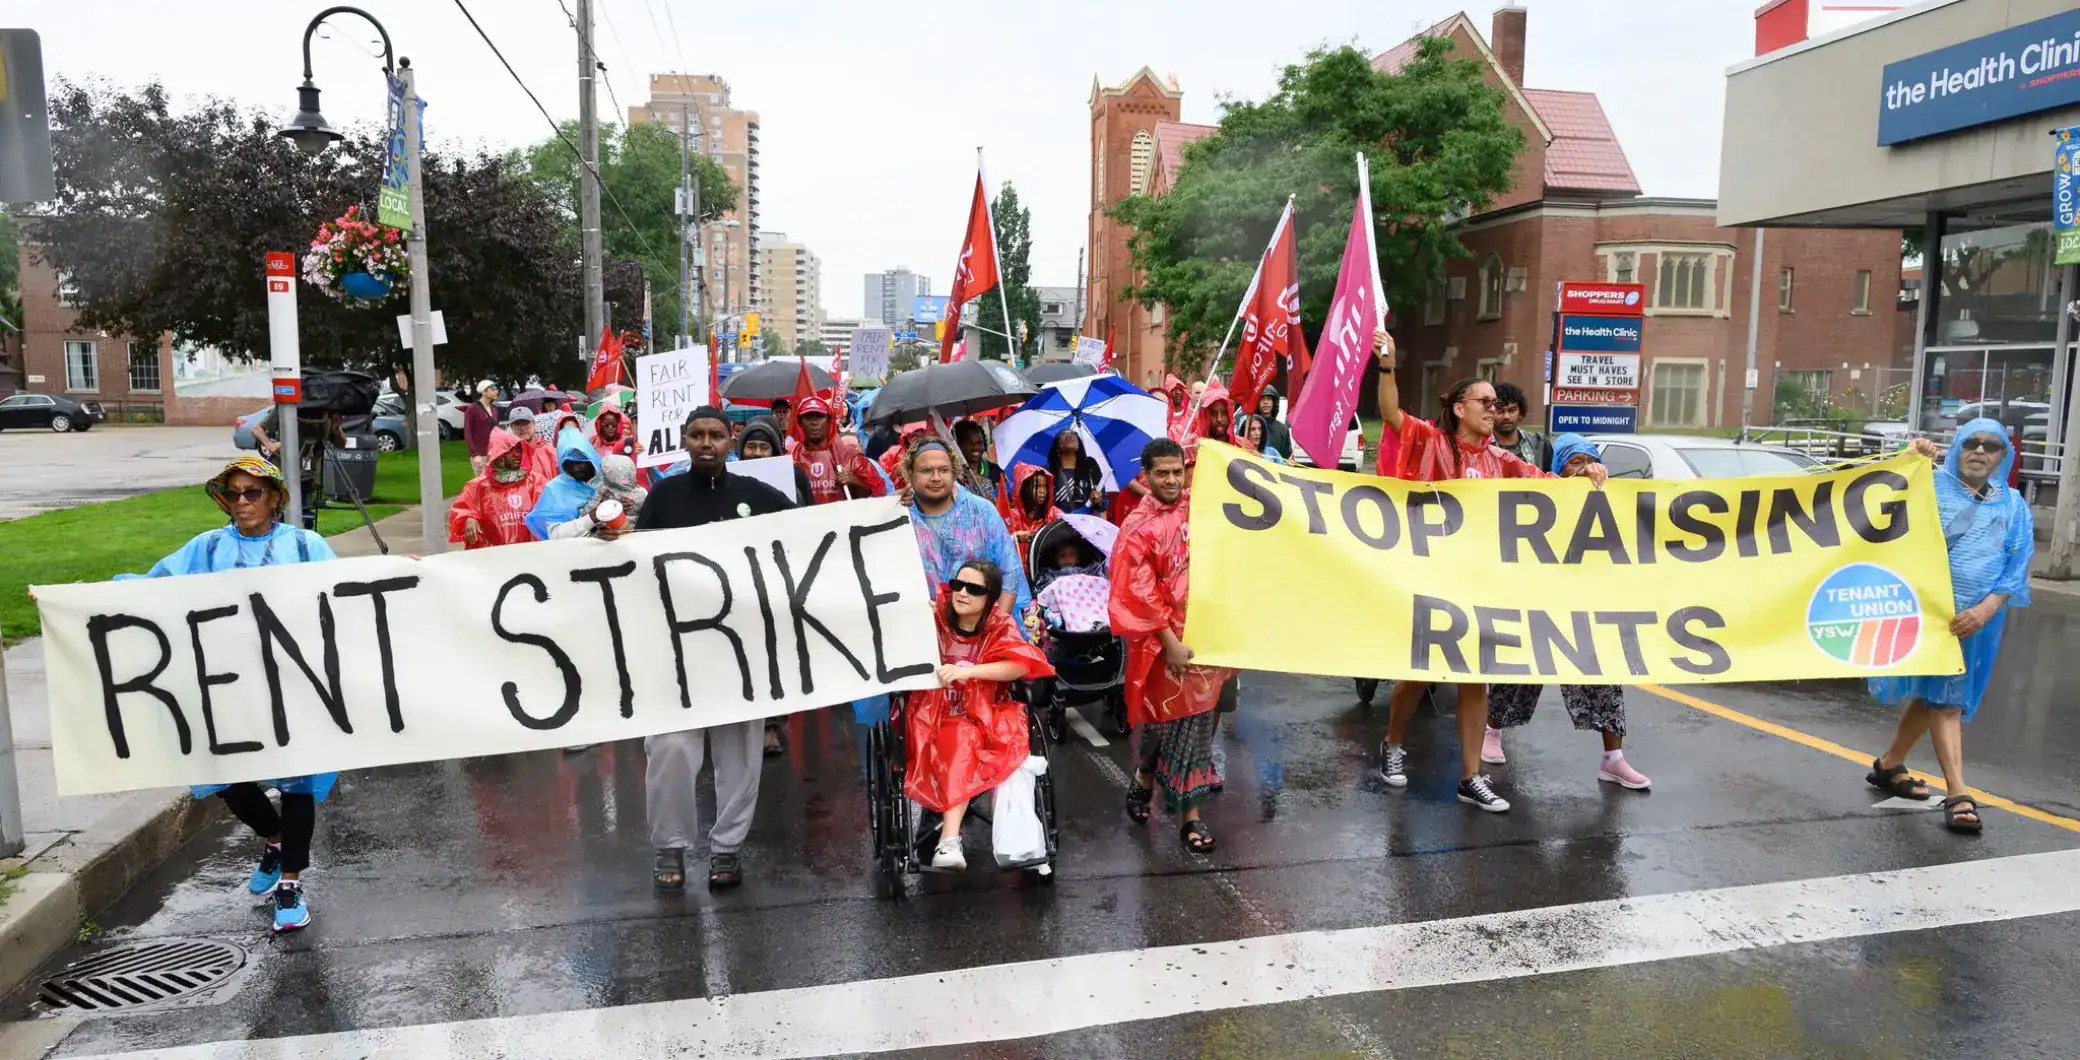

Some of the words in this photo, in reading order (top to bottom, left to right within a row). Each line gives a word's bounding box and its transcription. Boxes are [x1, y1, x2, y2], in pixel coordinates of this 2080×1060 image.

[1886, 80, 1926, 110] the
[1930, 53, 2015, 99] Health
[2020, 31, 2080, 75] Clini
[380, 193, 409, 215] LOCAL
[2059, 173, 2072, 225] GROW
[2060, 236, 2080, 250] LOC
[1567, 290, 1625, 299] SHOPPERS
[1565, 327, 1580, 336] the
[1582, 327, 1612, 337] Health
[1613, 328, 1637, 337] Clinic
[1581, 355, 1614, 364] TRAVEL
[650, 359, 691, 383] FAIR
[1570, 365, 1594, 374] MUST
[1598, 366, 1627, 375] HAVES
[1567, 375, 1582, 384] SEE
[1588, 377, 1598, 385] IN
[1605, 376, 1634, 386] STORE
[652, 384, 695, 408] RENT
[1557, 390, 1616, 402] PARKING
[661, 407, 686, 422] FOR
[1558, 416, 1579, 424] OPEN
[1581, 416, 1591, 424] TO
[1592, 416, 1629, 425] MIDNIGHT
[1223, 458, 1463, 556] STOP
[1499, 470, 1910, 564] RAISING
[1826, 584, 1902, 602] TENANT
[1850, 599, 1913, 617] UNION
[87, 575, 419, 758] RENT
[492, 515, 935, 730] STRIKE
[1411, 594, 1732, 677] RENTS
[1813, 624, 1856, 640] YSW
